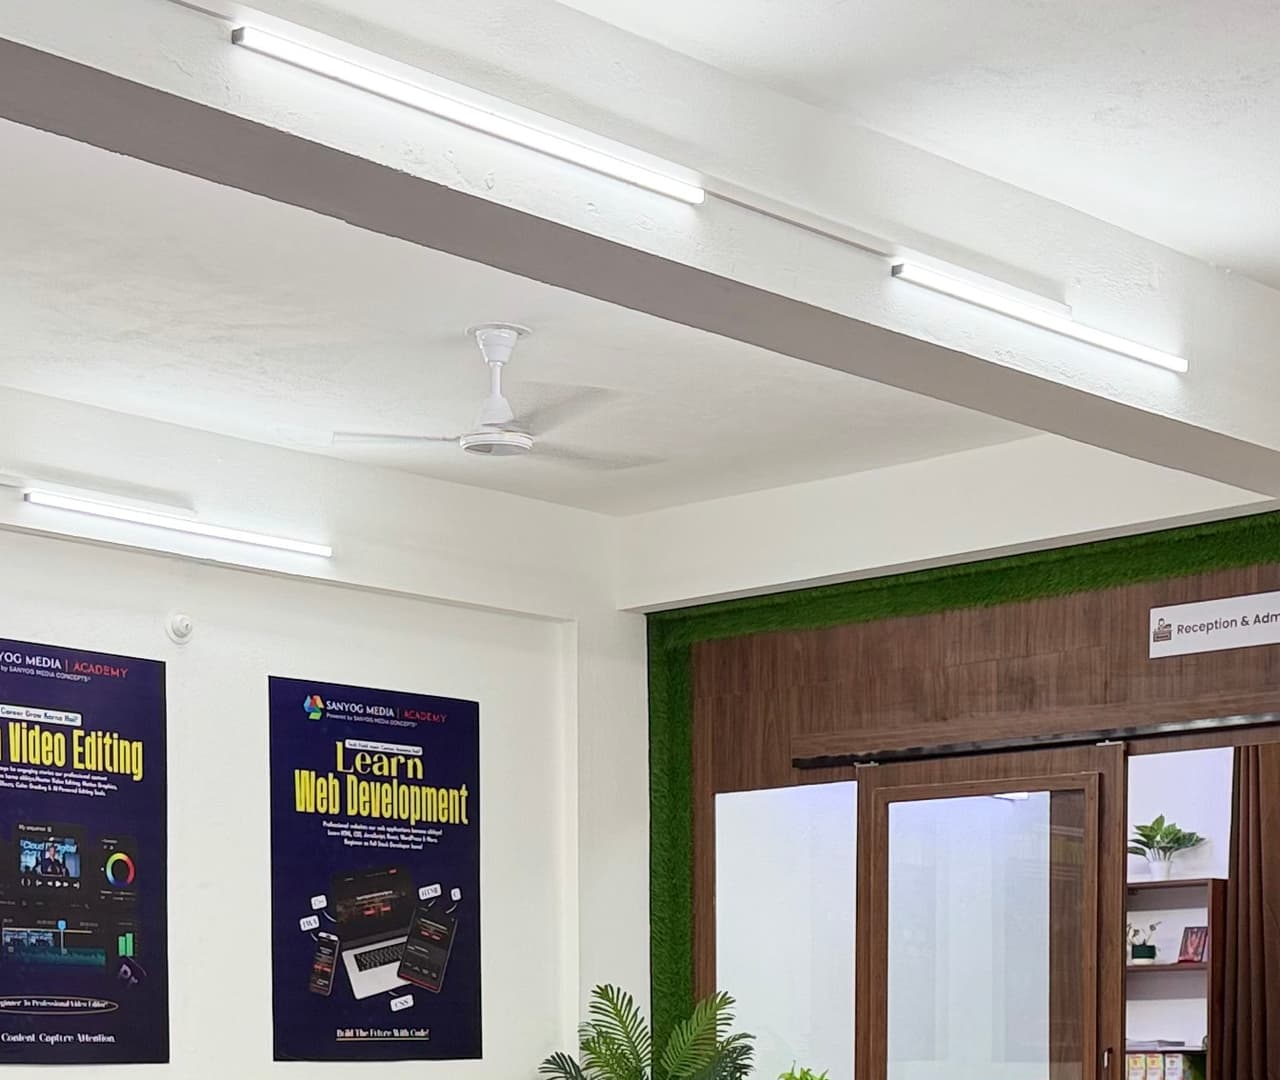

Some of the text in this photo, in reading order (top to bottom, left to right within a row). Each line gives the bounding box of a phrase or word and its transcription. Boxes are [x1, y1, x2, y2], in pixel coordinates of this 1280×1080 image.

[1177, 617, 1237, 635] Reception
[1241, 615, 1250, 627] &
[25, 656, 61, 669] MEDIA
[73, 661, 128, 678] ACADEMY
[326, 700, 448, 723] SANYOG MEDIA ACADEMY
[8, 721, 66, 768] Video
[73, 729, 143, 781] Editing
[336, 741, 424, 779] Learn
[294, 769, 469, 825] Web Development
